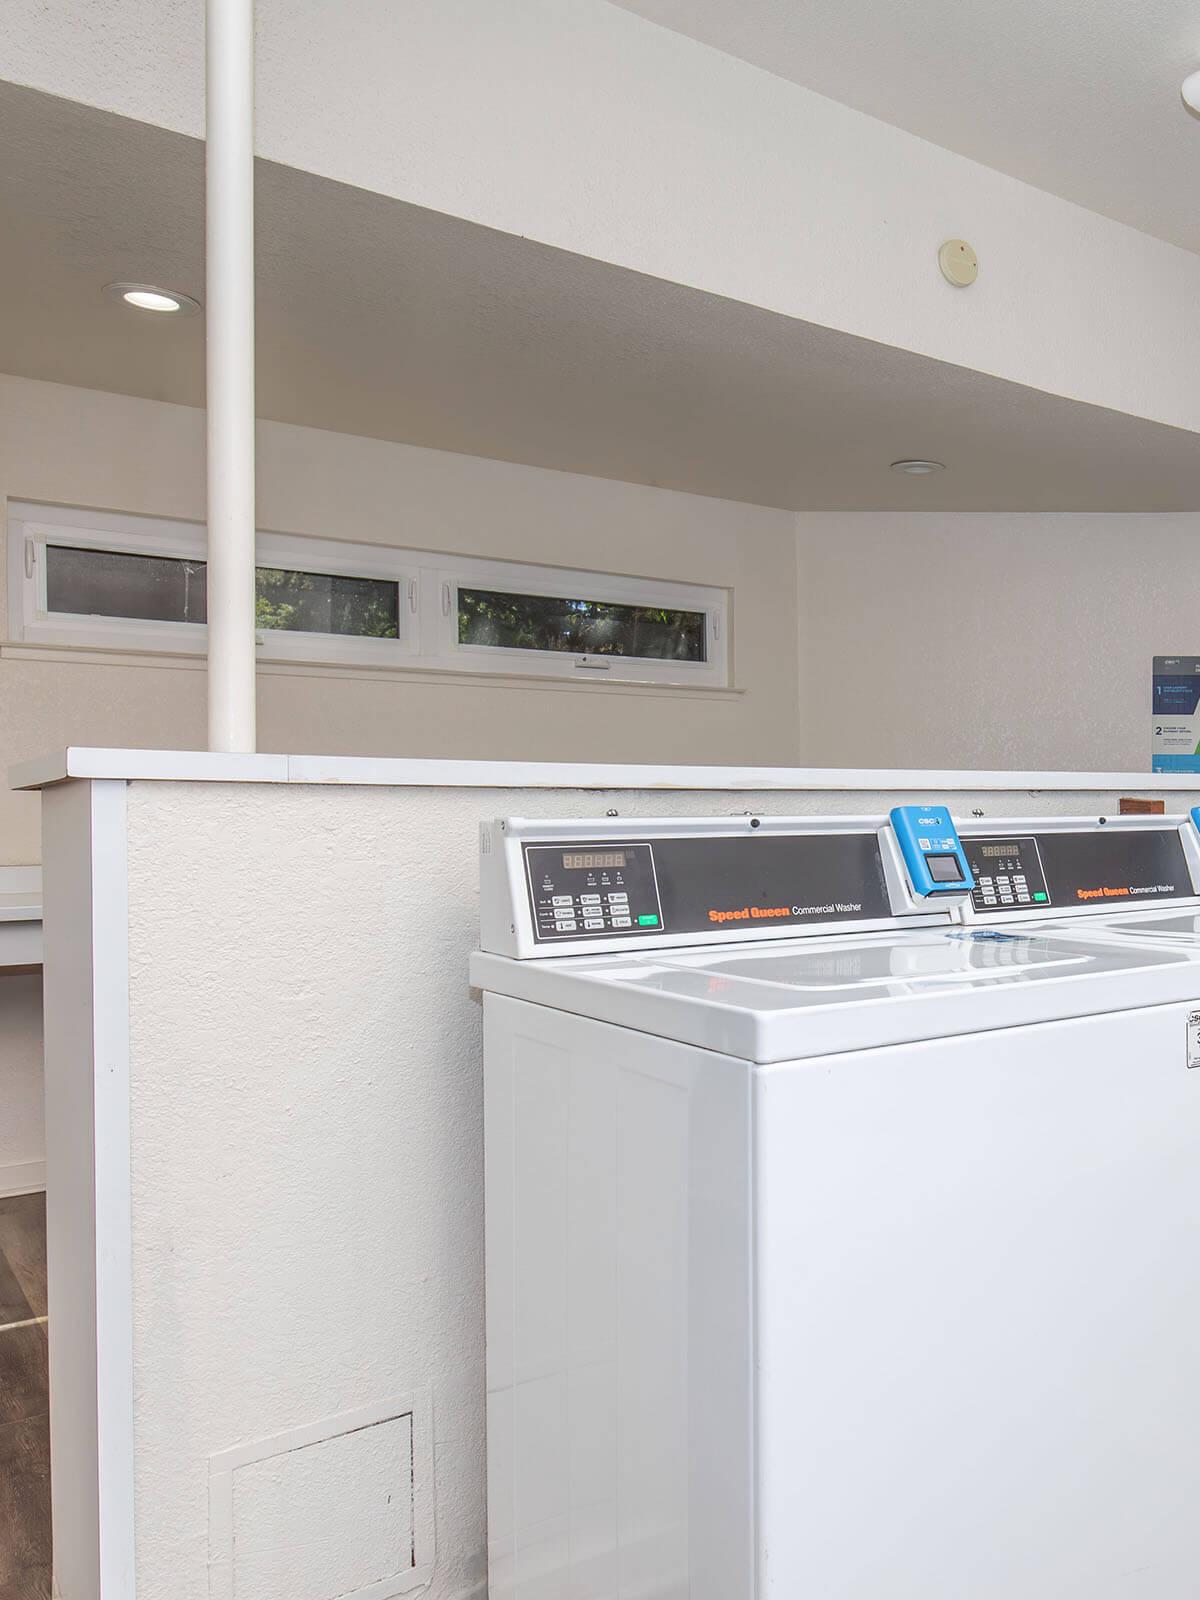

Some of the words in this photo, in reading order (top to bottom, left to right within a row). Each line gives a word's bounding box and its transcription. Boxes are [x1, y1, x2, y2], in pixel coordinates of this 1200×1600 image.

[1155, 726, 1163, 736] 2
[1077, 888, 1104, 900] Speed
[1104, 887, 1129, 897] Queen
[1129, 885, 1157, 895] Commercial
[1157, 884, 1175, 893] Washer
[708, 908, 750, 923] Speed
[750, 907, 790, 919] Queen
[792, 903, 835, 916] Commercial
[835, 902, 863, 913] Washer
